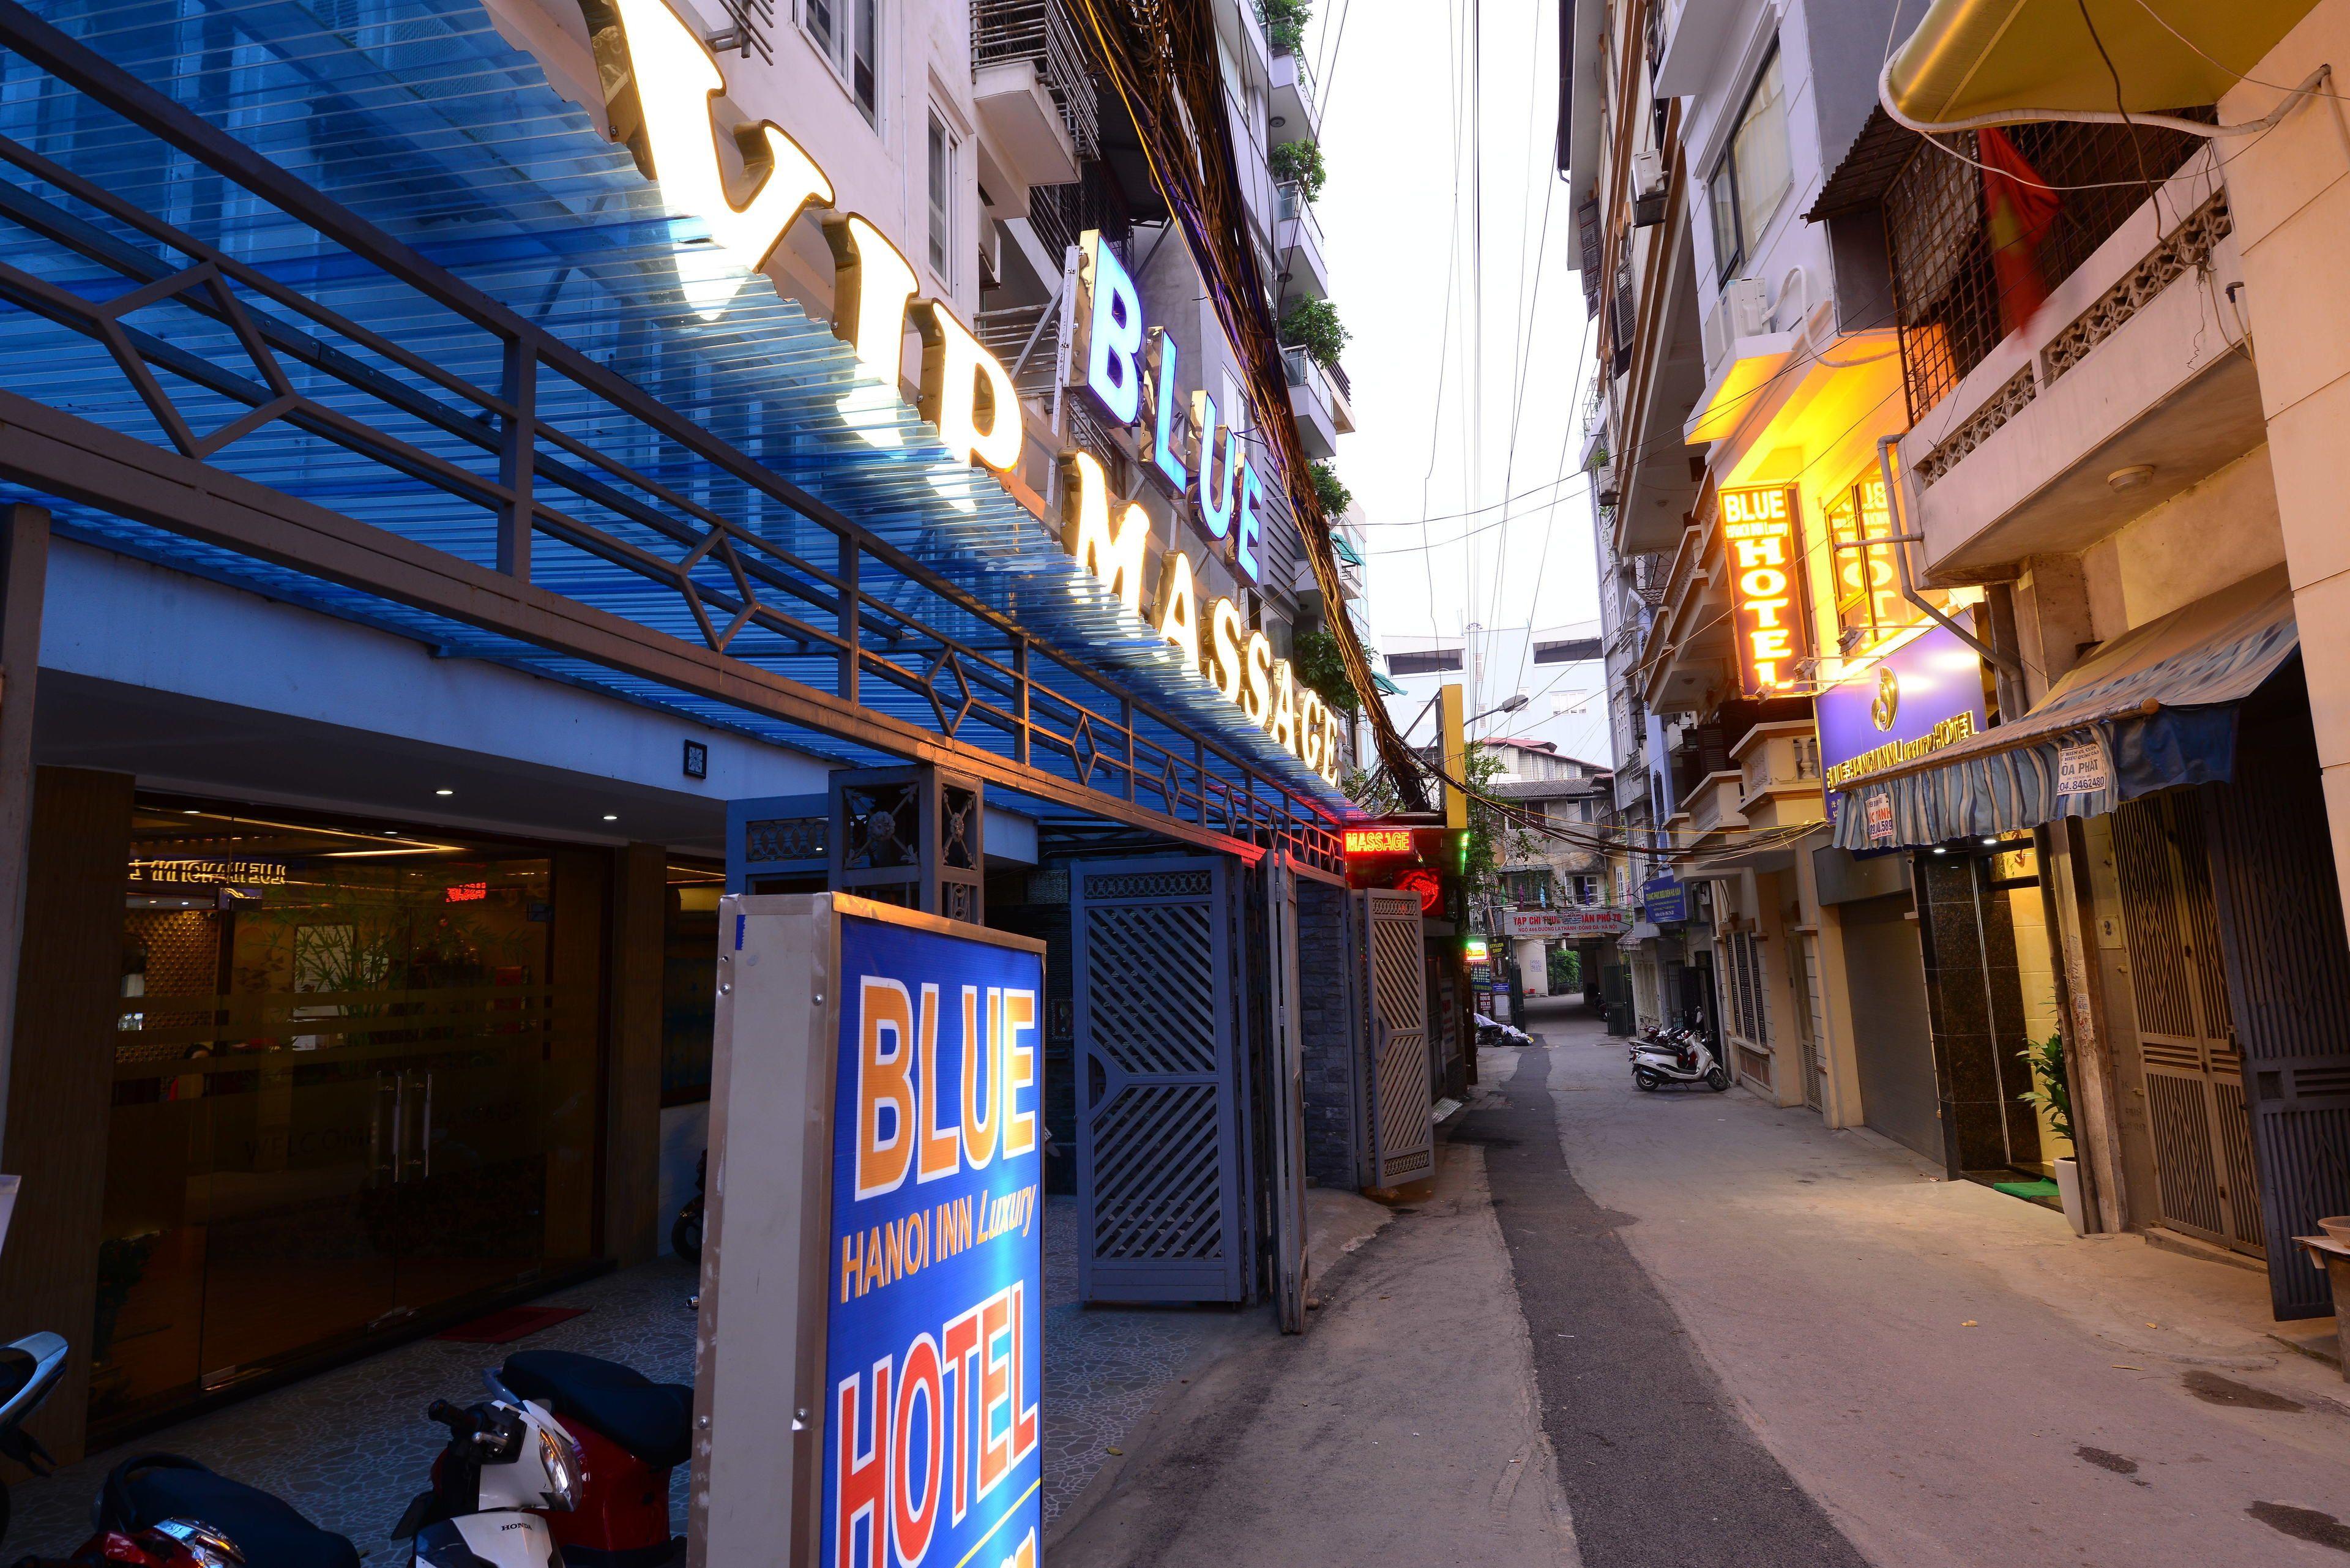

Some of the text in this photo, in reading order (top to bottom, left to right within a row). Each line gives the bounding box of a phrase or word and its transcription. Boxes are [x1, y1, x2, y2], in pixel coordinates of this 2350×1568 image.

[619, 0, 1340, 788] VIP MASSAGE
[1081, 230, 1264, 588] BLUE
[1723, 490, 1786, 523] BLUE
[1733, 537, 1794, 691] HOTEL
[1933, 710, 1980, 750] HOTEL
[2078, 758, 2098, 774] PHÁT
[1346, 832, 1409, 851] MASSAGE
[854, 974, 1036, 1201] BLUE
[841, 1184, 1037, 1304] HANOI INN Luxury
[834, 1279, 1038, 1568] HOTEL
